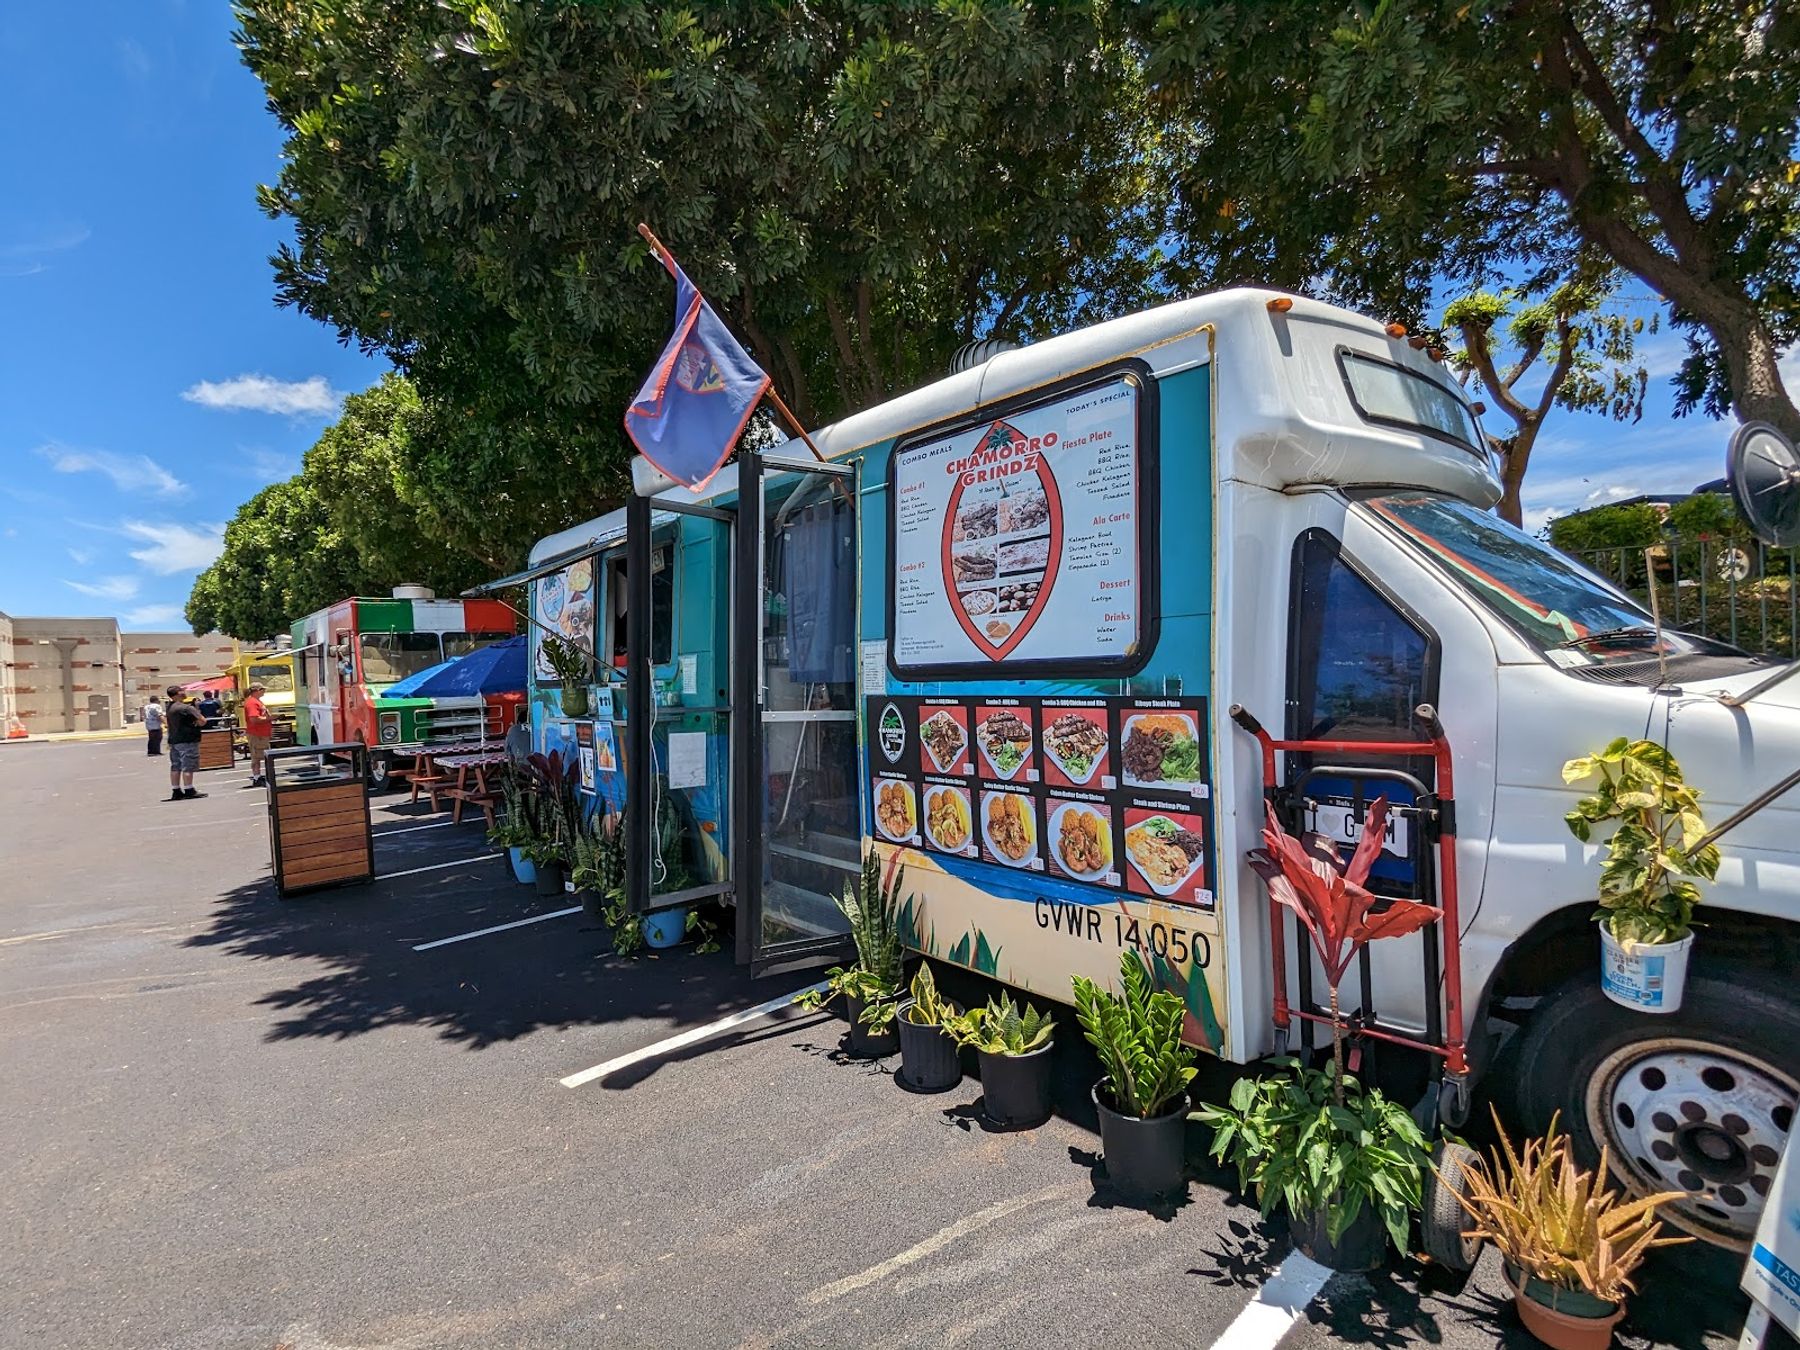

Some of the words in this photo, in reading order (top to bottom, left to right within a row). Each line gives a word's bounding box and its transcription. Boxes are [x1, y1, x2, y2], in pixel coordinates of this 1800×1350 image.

[1066, 401, 1097, 415] TODAY'S
[1100, 390, 1131, 405] SPECIAL
[1062, 438, 1087, 451] Fiesta
[1089, 430, 1112, 443] Plate
[902, 453, 927, 466] COMBO
[929, 444, 953, 457] MEALS
[946, 432, 1059, 475] CHAMORRO
[1098, 456, 1112, 464] BBQ
[962, 454, 1037, 486] GRINDZ
[1093, 516, 1106, 526] Ala
[1109, 512, 1131, 522] Carte
[1100, 579, 1130, 590] Dessert
[1104, 611, 1131, 622] Drinks
[1345, 813, 1396, 844] GM
[1035, 896, 1103, 943] GVWR
